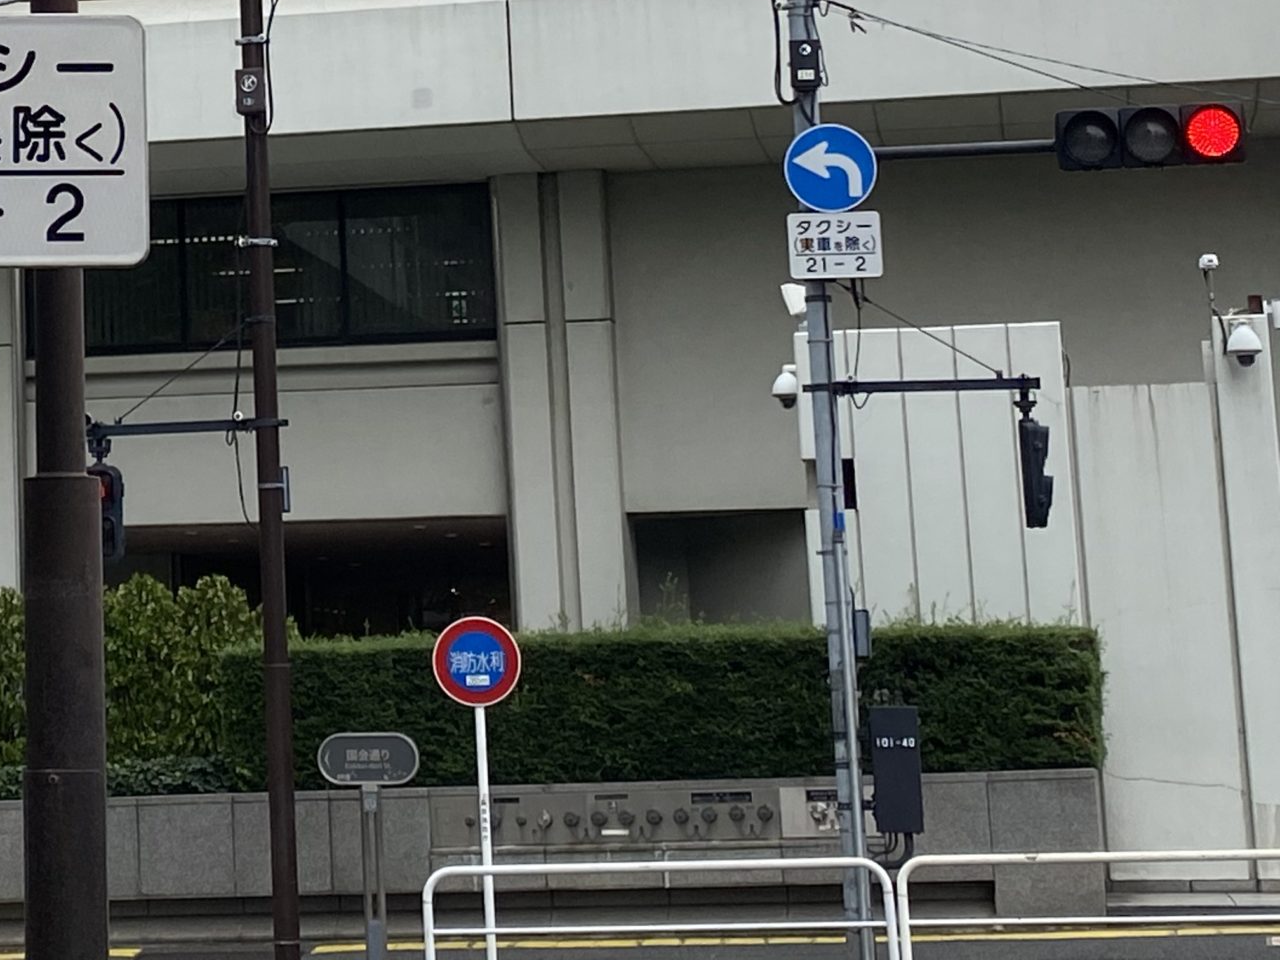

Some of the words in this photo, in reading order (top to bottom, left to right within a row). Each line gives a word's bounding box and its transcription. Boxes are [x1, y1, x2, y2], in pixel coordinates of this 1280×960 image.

[796, 219, 872, 235] タクシー
[793, 234, 876, 253] (実車を除く)
[449, 650, 506, 674] 消防水利
[875, 737, 916, 748] 101-40
